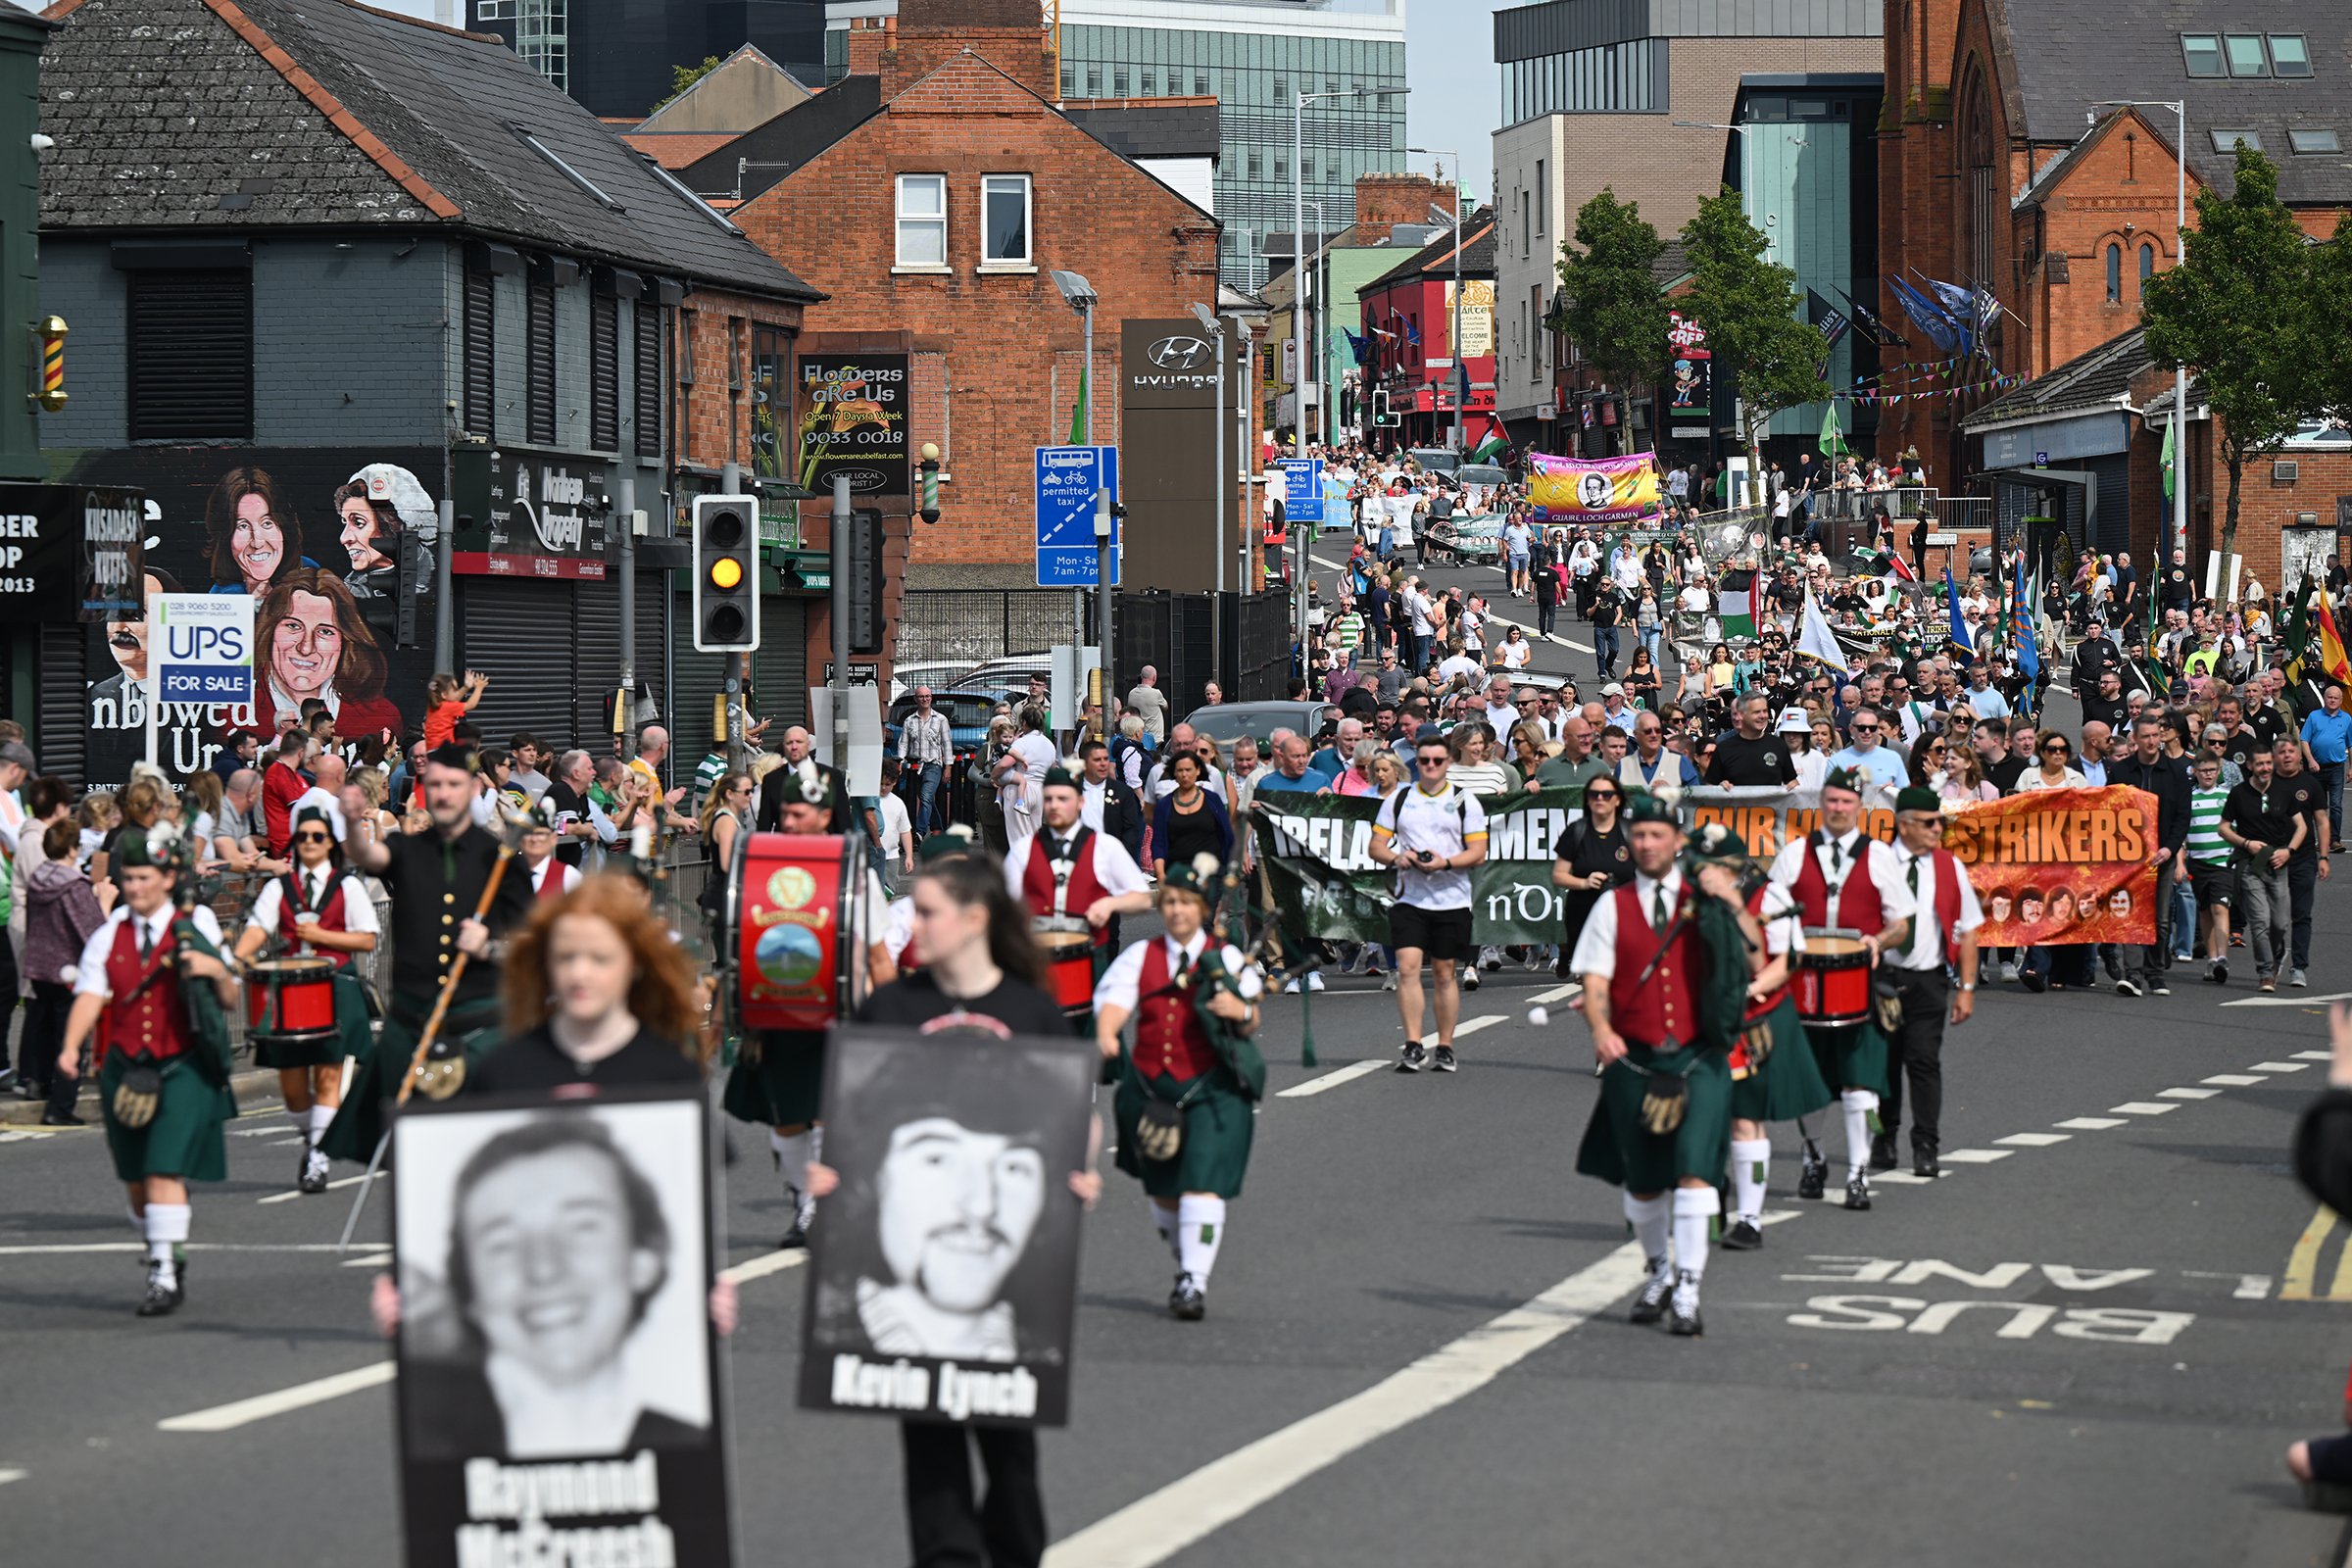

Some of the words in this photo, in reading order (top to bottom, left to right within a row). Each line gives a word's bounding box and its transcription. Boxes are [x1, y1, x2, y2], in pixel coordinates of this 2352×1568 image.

[1134, 375, 1223, 390] HYUNDA
[805, 412, 831, 423] Open
[835, 412, 840, 420] 7
[843, 412, 865, 422] Days
[877, 411, 903, 420] Week
[807, 432, 851, 444] 9033
[858, 431, 903, 444] 0018
[543, 466, 583, 504] Northern
[1043, 487, 1089, 497] permitted
[1057, 497, 1075, 506] taxi
[1605, 512, 1639, 521] GARMAN
[542, 505, 583, 551] Property
[1056, 557, 1077, 565] Mon
[1085, 557, 1099, 565] Sa
[187, 602, 209, 611] 9060
[211, 603, 232, 612] 5200
[1927, 624, 1945, 633] TRIKE
[170, 626, 243, 660] UPS
[168, 676, 200, 690] FOR
[205, 676, 244, 691] SALE
[1954, 808, 2143, 864] STRIKERS
[1787, 1295, 2196, 1344] BUS
[832, 1353, 930, 1410] Kevin
[938, 1361, 1038, 1420] Lynch
[466, 1449, 659, 1531] Raymond
